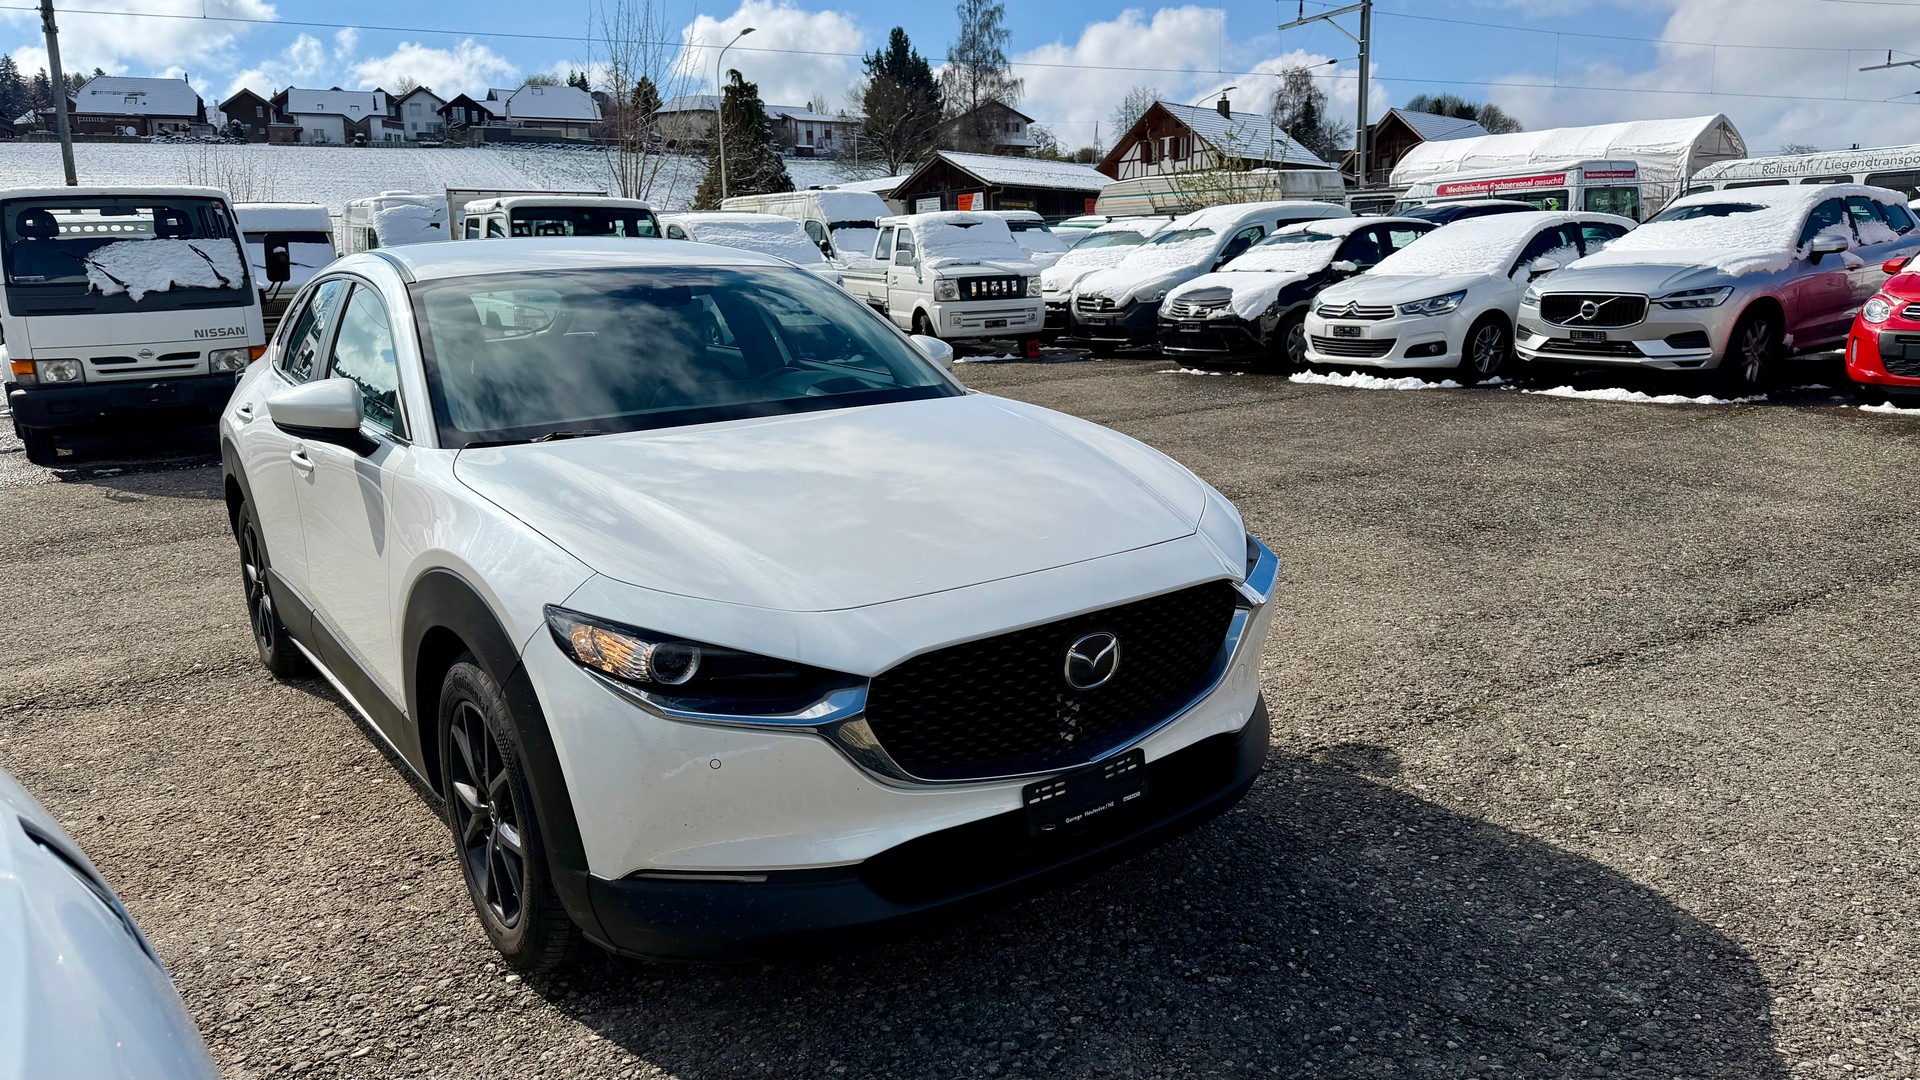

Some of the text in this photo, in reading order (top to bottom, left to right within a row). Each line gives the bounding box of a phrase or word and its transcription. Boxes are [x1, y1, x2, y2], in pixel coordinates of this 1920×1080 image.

[1762, 161, 1813, 175] Rollstuhl-
[1446, 176, 1564, 194] Medizinisches Fachpersonal gesucht!
[194, 326, 245, 338] NISSAN
[453, 672, 488, 720] Continental
[1065, 814, 1082, 823] Garage
